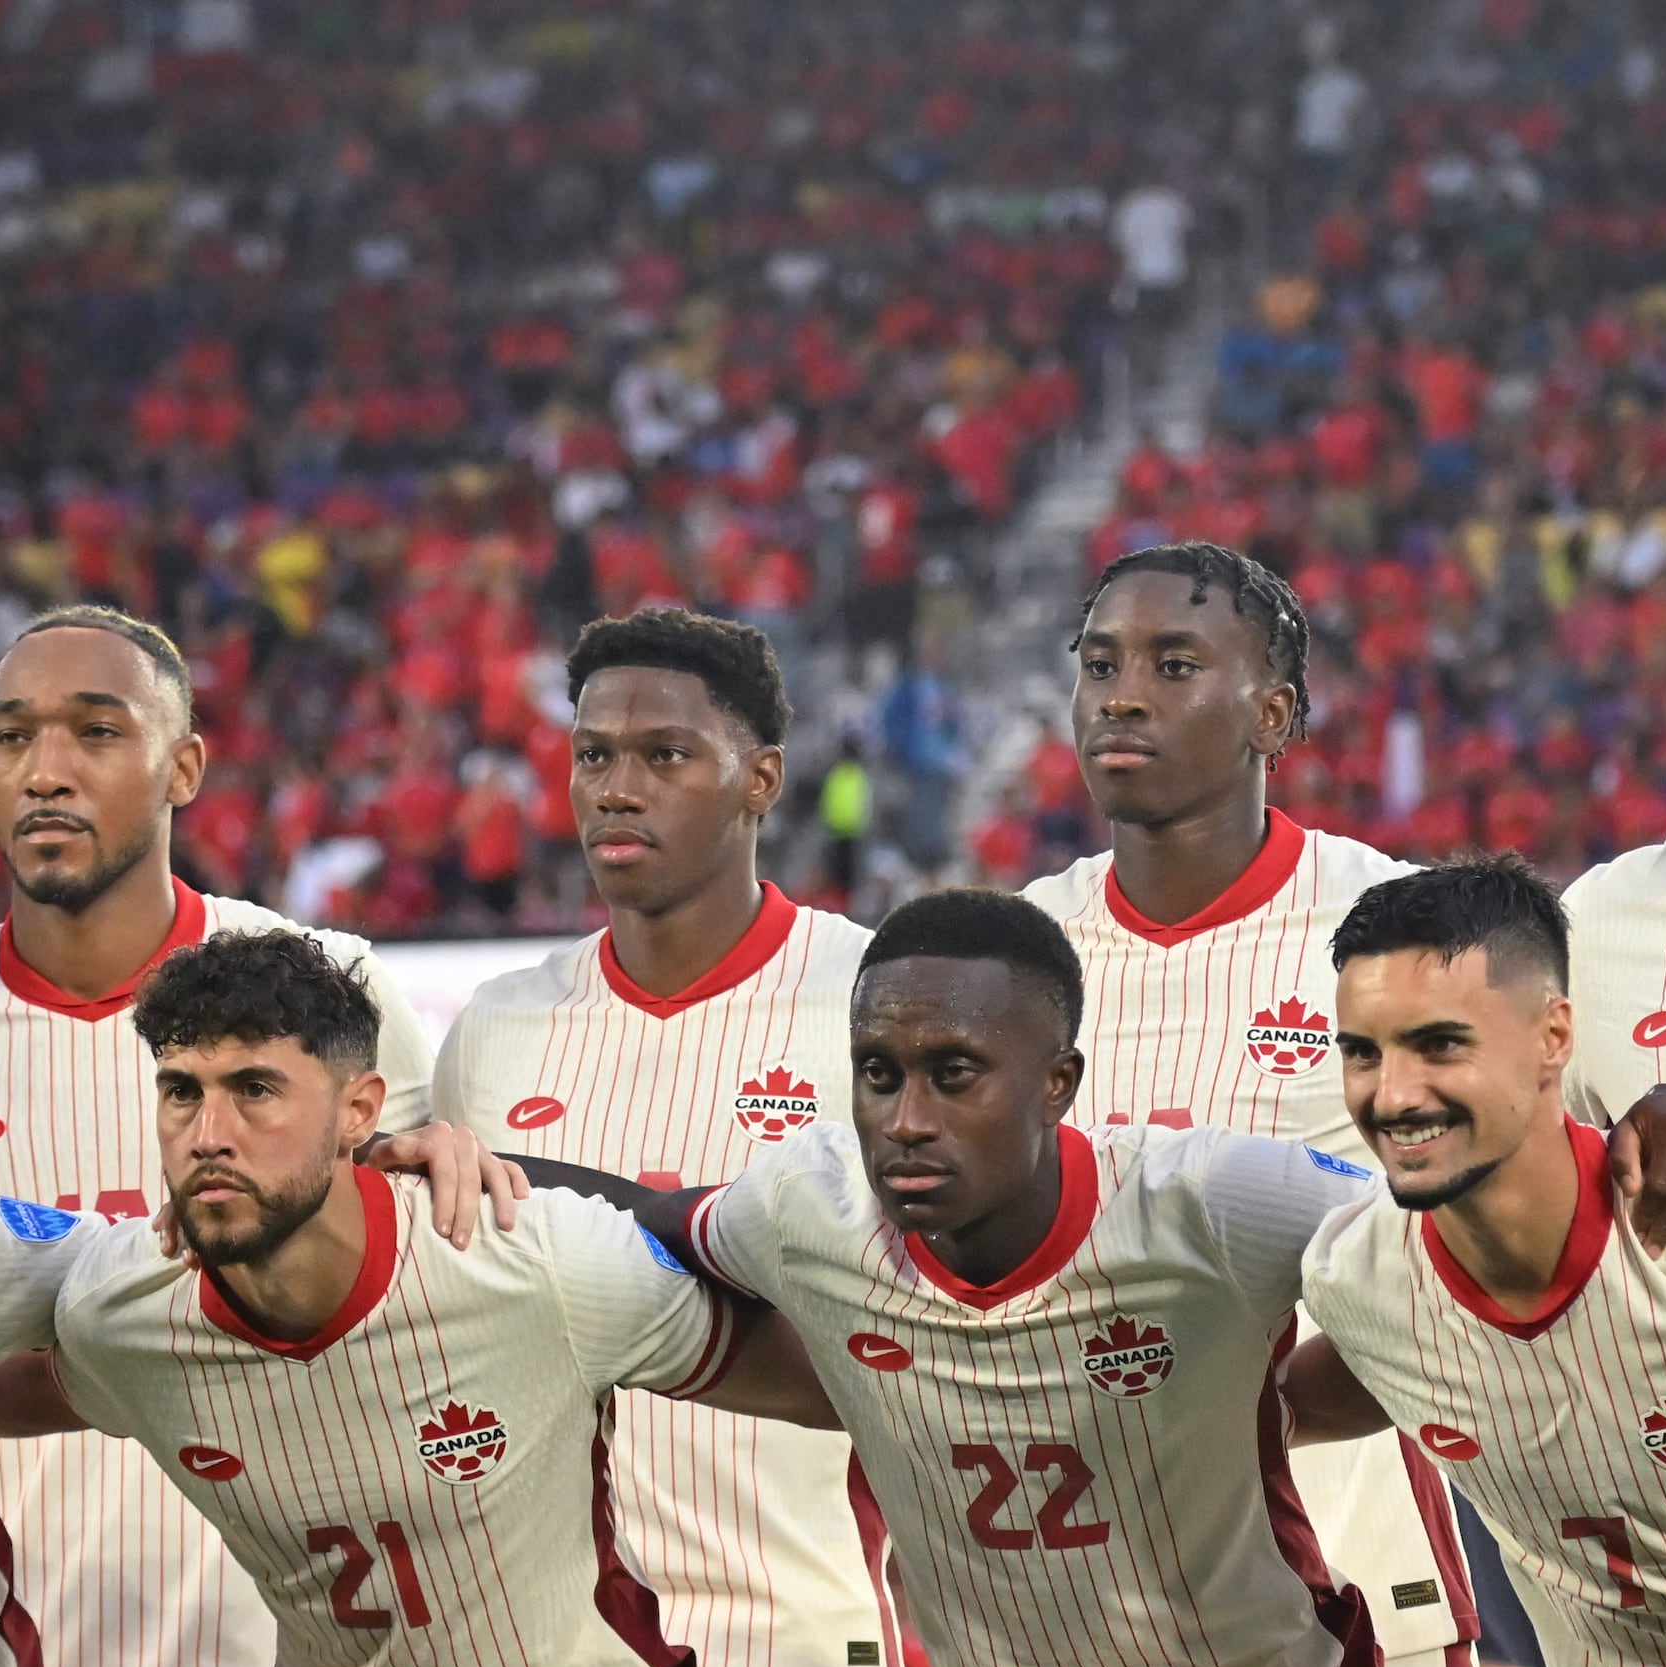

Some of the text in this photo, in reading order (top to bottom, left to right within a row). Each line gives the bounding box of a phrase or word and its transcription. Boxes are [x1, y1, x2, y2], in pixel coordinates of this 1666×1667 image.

[1247, 1029, 1330, 1046] CANADA
[735, 1098, 817, 1113] CANADA
[1084, 1345, 1174, 1371] CANADA
[419, 1428, 506, 1456] CANADA
[952, 1444, 1110, 1549] 22
[306, 1521, 432, 1629] 21
[1561, 1517, 1645, 1609] 7
